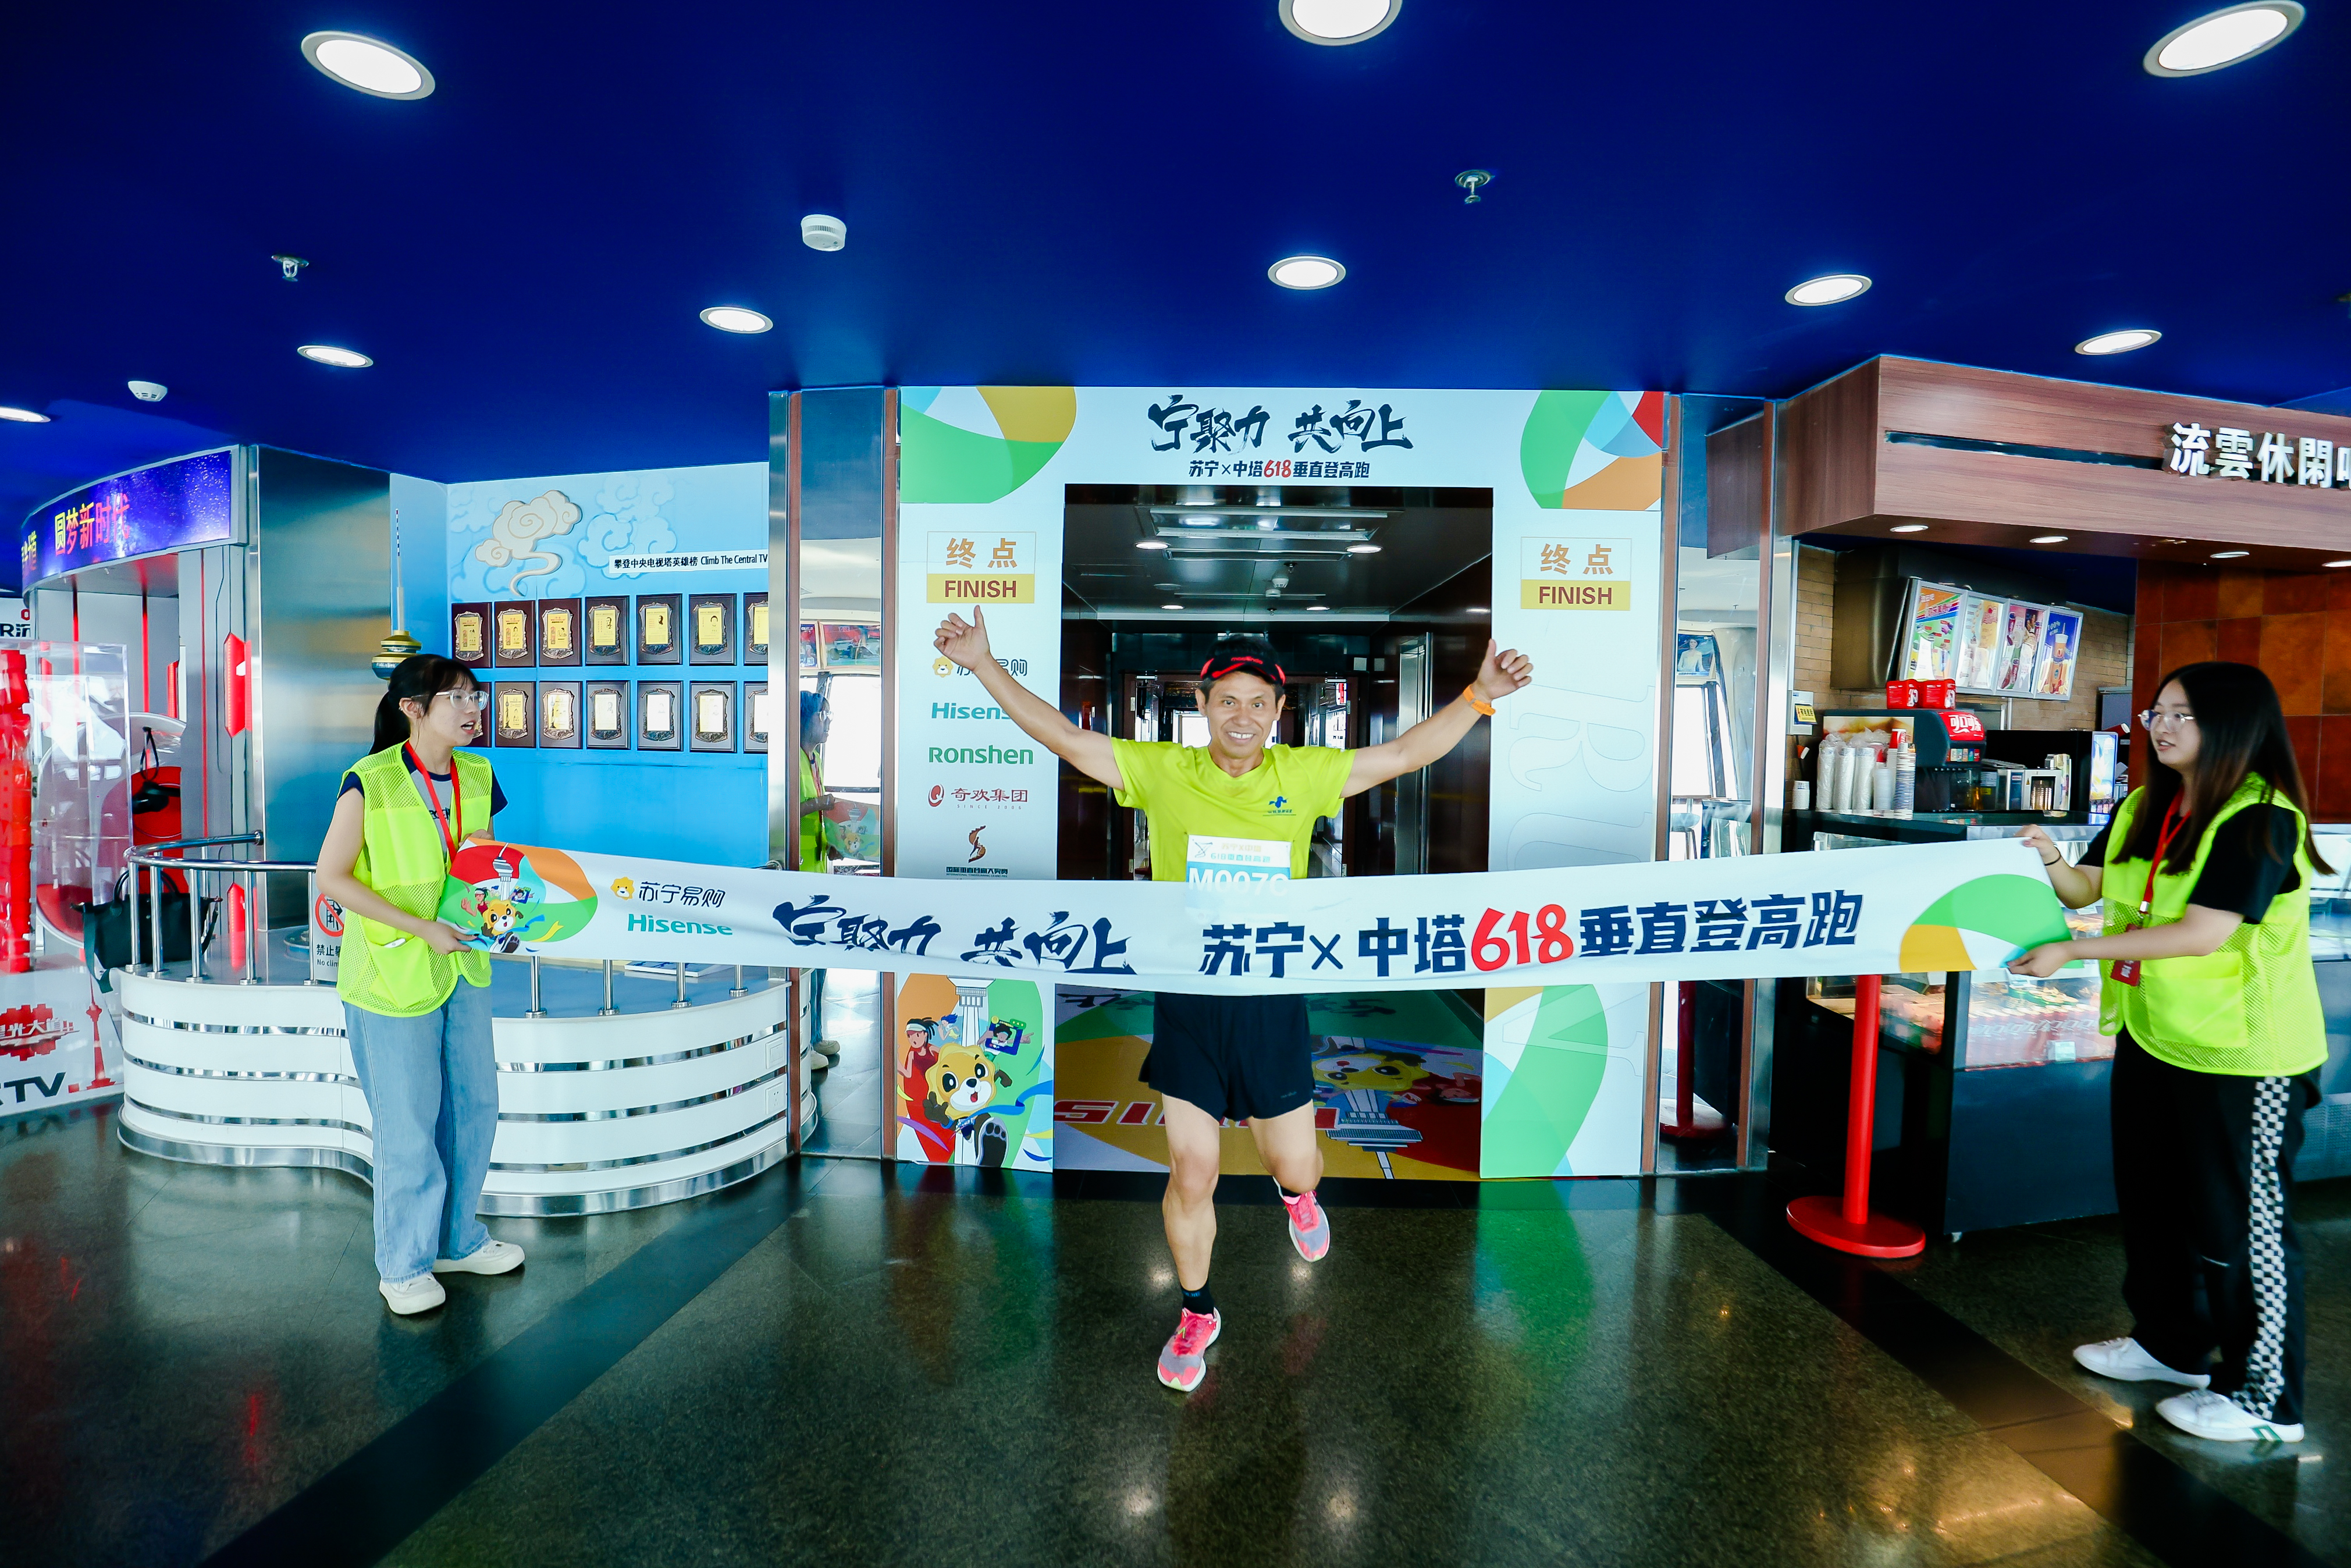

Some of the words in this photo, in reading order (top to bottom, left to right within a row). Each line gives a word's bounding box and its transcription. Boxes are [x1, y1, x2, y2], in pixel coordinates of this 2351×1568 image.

[1147, 394, 1271, 454] 宁聚力
[1287, 399, 1414, 454] 共向上
[54, 493, 130, 555] 圆梦新时代
[614, 557, 698, 570] 攀登中央电视塔英雄榜
[701, 556, 719, 566] Climb
[721, 555, 733, 564] The
[734, 554, 757, 564] Central
[759, 554, 768, 563] TV
[945, 538, 1018, 569] 终点
[1540, 543, 1613, 575] 终点
[944, 580, 1017, 598] FINISH
[1539, 586, 1612, 605] FINISH
[951, 787, 1028, 803] 奇欢集团
[639, 881, 727, 908] 苏宁易购
[627, 913, 734, 936] Hisense
[772, 894, 941, 956] 宁聚力
[960, 911, 1138, 975] 共向上
[0, 1072, 66, 1106] TV
